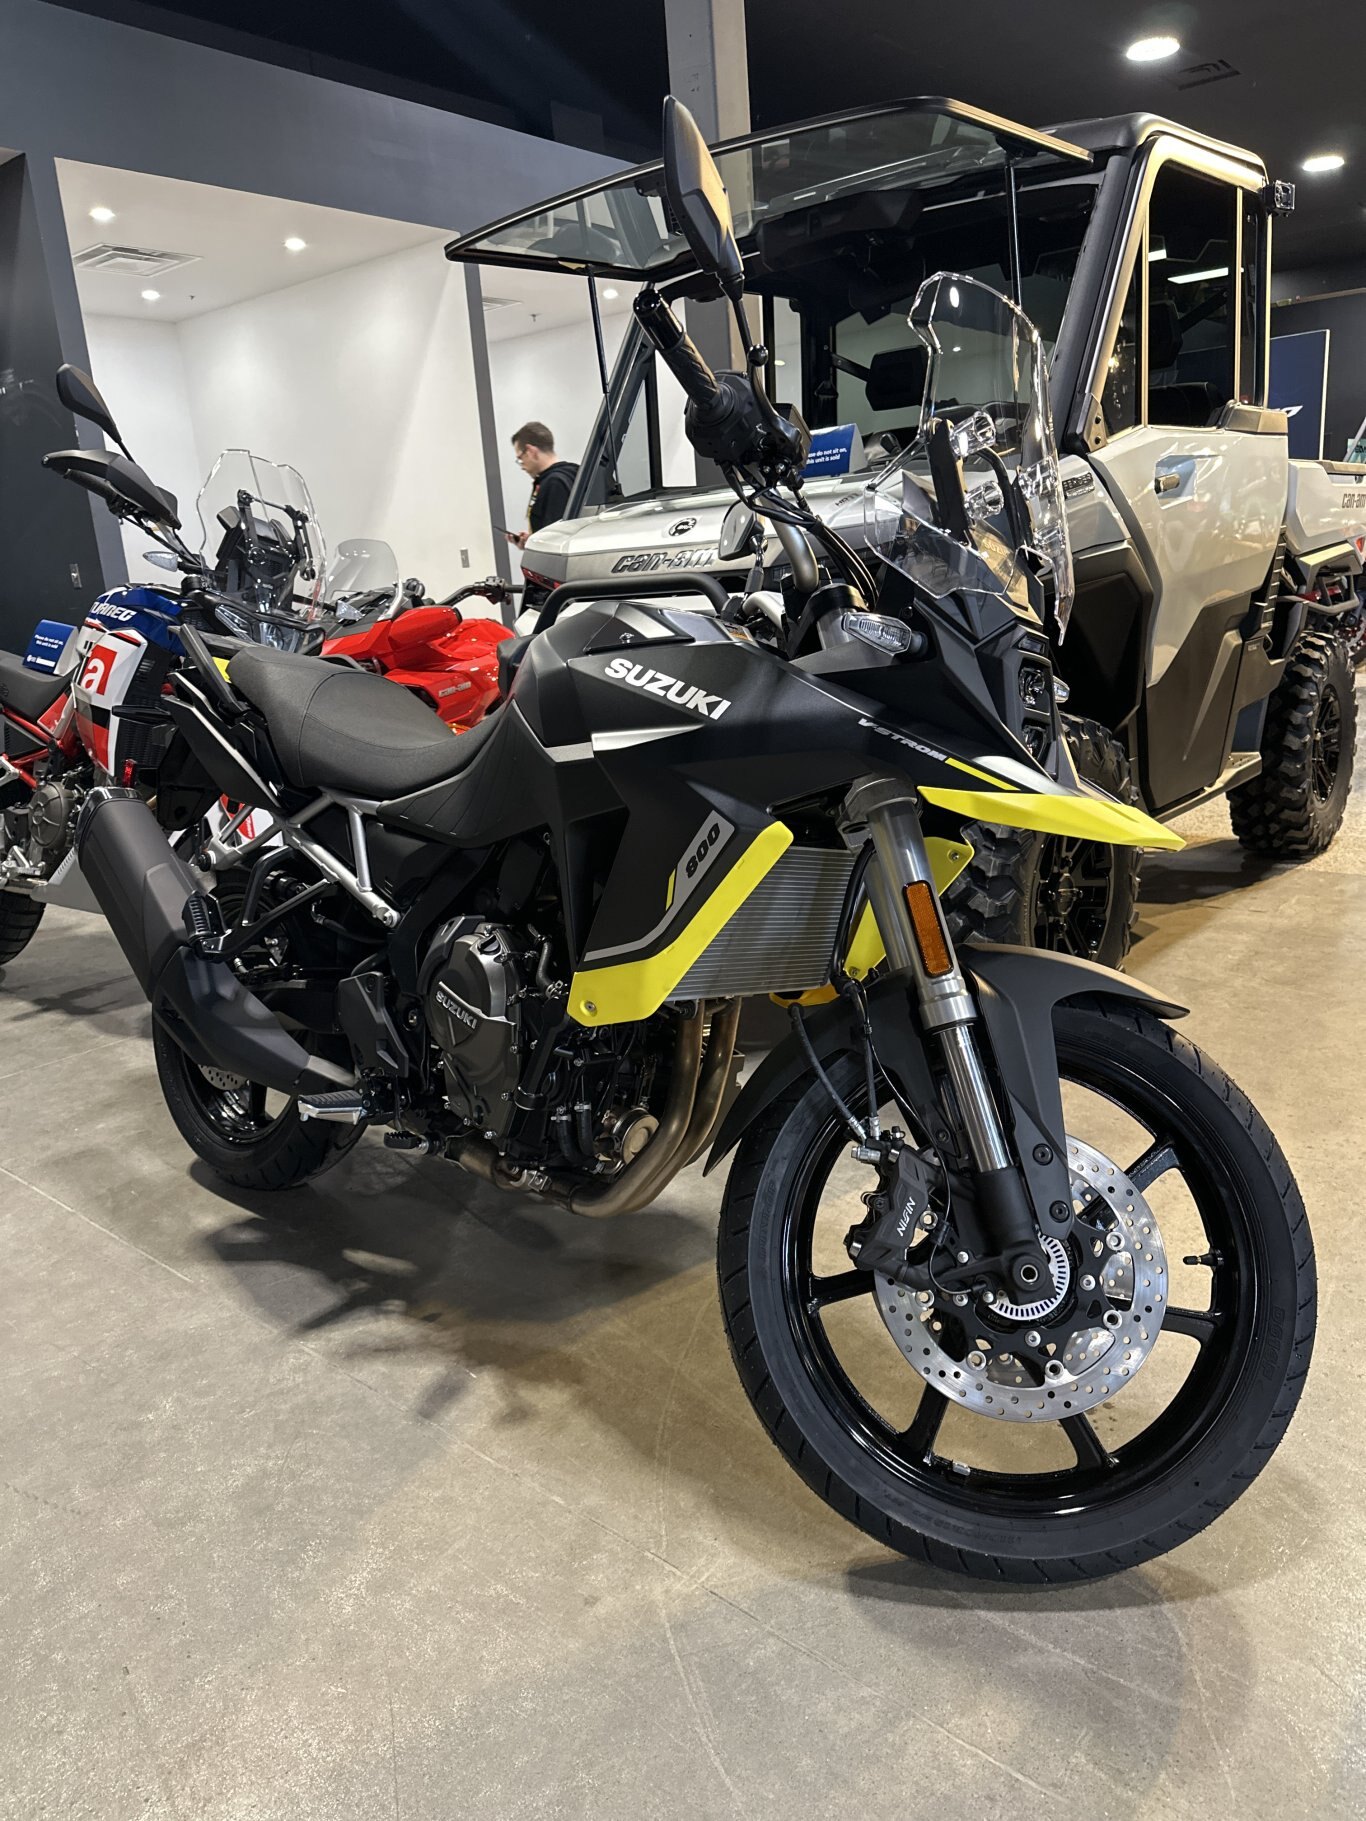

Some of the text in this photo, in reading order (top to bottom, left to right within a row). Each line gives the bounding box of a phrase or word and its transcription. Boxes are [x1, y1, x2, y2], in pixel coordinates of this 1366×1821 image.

[604, 658, 732, 720] SUZUKI
[686, 823, 720, 879] 800
[436, 991, 478, 1029] SUZUKI
